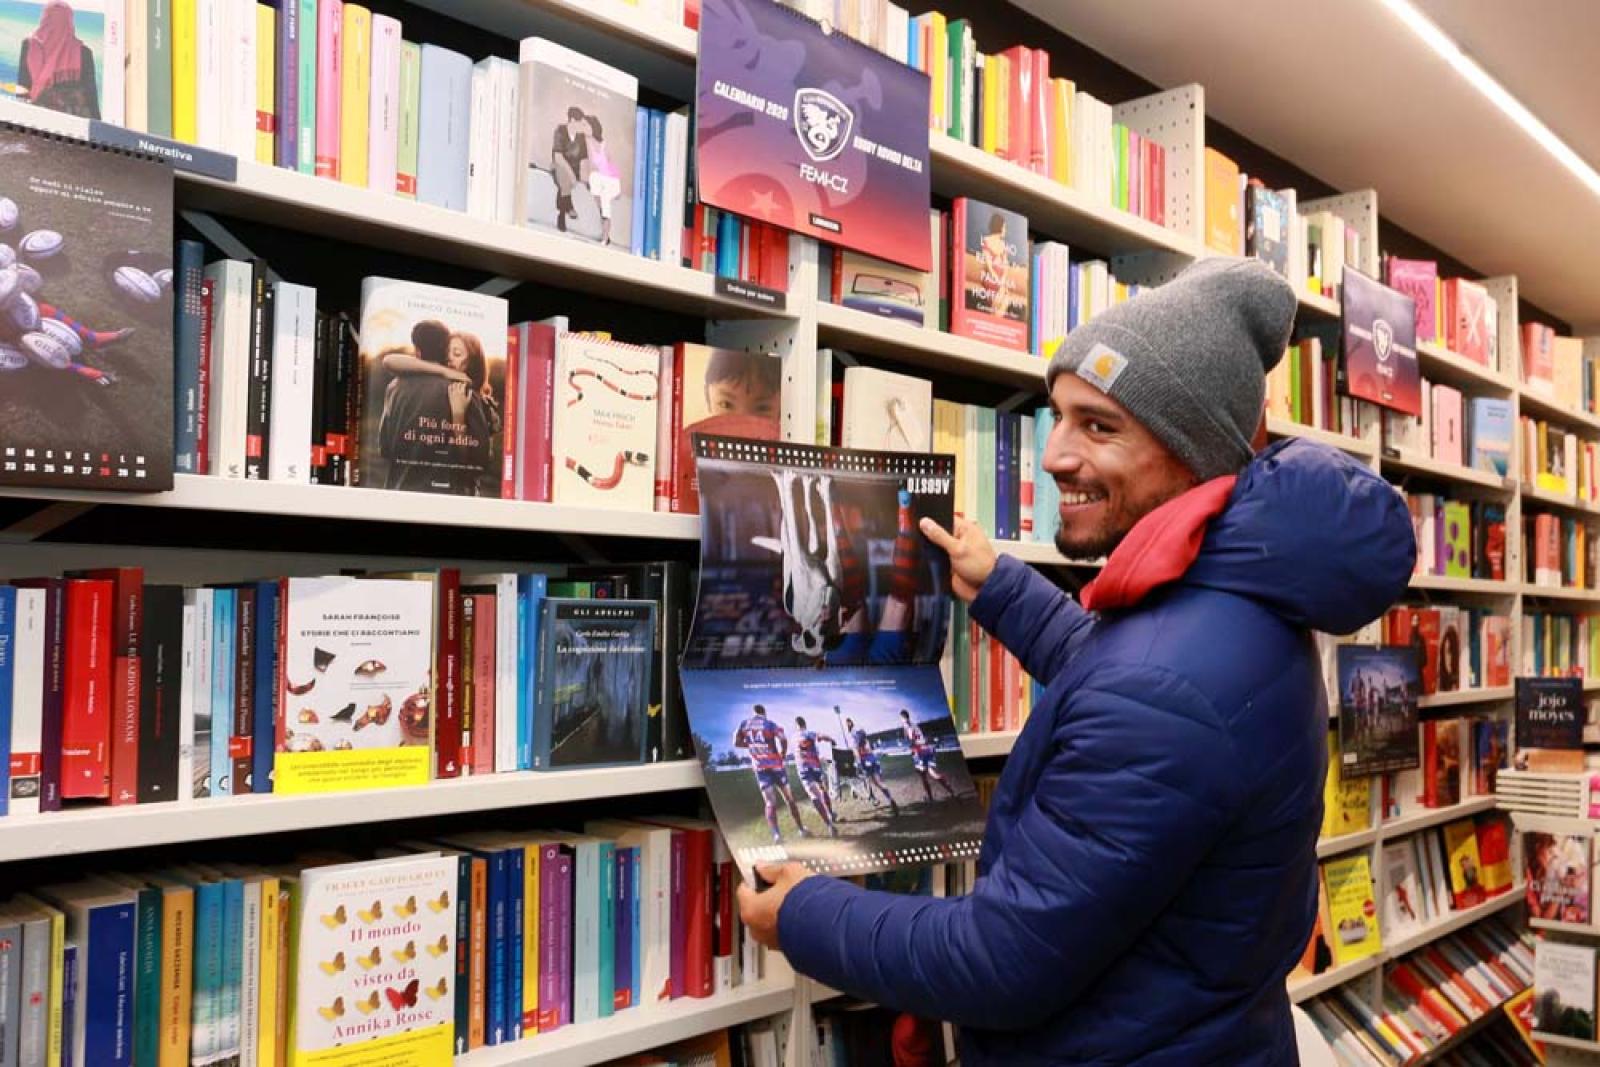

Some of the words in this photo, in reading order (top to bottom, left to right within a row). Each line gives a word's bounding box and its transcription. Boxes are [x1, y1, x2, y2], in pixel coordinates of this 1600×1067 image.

[713, 80, 765, 112] CALENDARIO
[766, 101, 789, 120] 2020
[138, 139, 193, 162] Narrativa
[799, 162, 849, 193] FEMI-CZ
[418, 416, 437, 429] Più
[441, 419, 467, 432] forte
[404, 429, 416, 441] di
[420, 433, 445, 445] ogni
[448, 434, 479, 448] addio
[907, 477, 949, 494] AGOSTO
[353, 613, 400, 621] FRANÇOISE
[573, 608, 590, 616] GLI
[594, 608, 634, 617] ADELPHI
[1539, 692, 1566, 708] jojo
[1529, 709, 1575, 724] moyes
[350, 928, 363, 943] Il
[368, 921, 421, 940] mondo
[354, 972, 393, 988] visto
[397, 967, 415, 980] da
[333, 1018, 391, 1039] Annika
[397, 1010, 432, 1026] Rose
